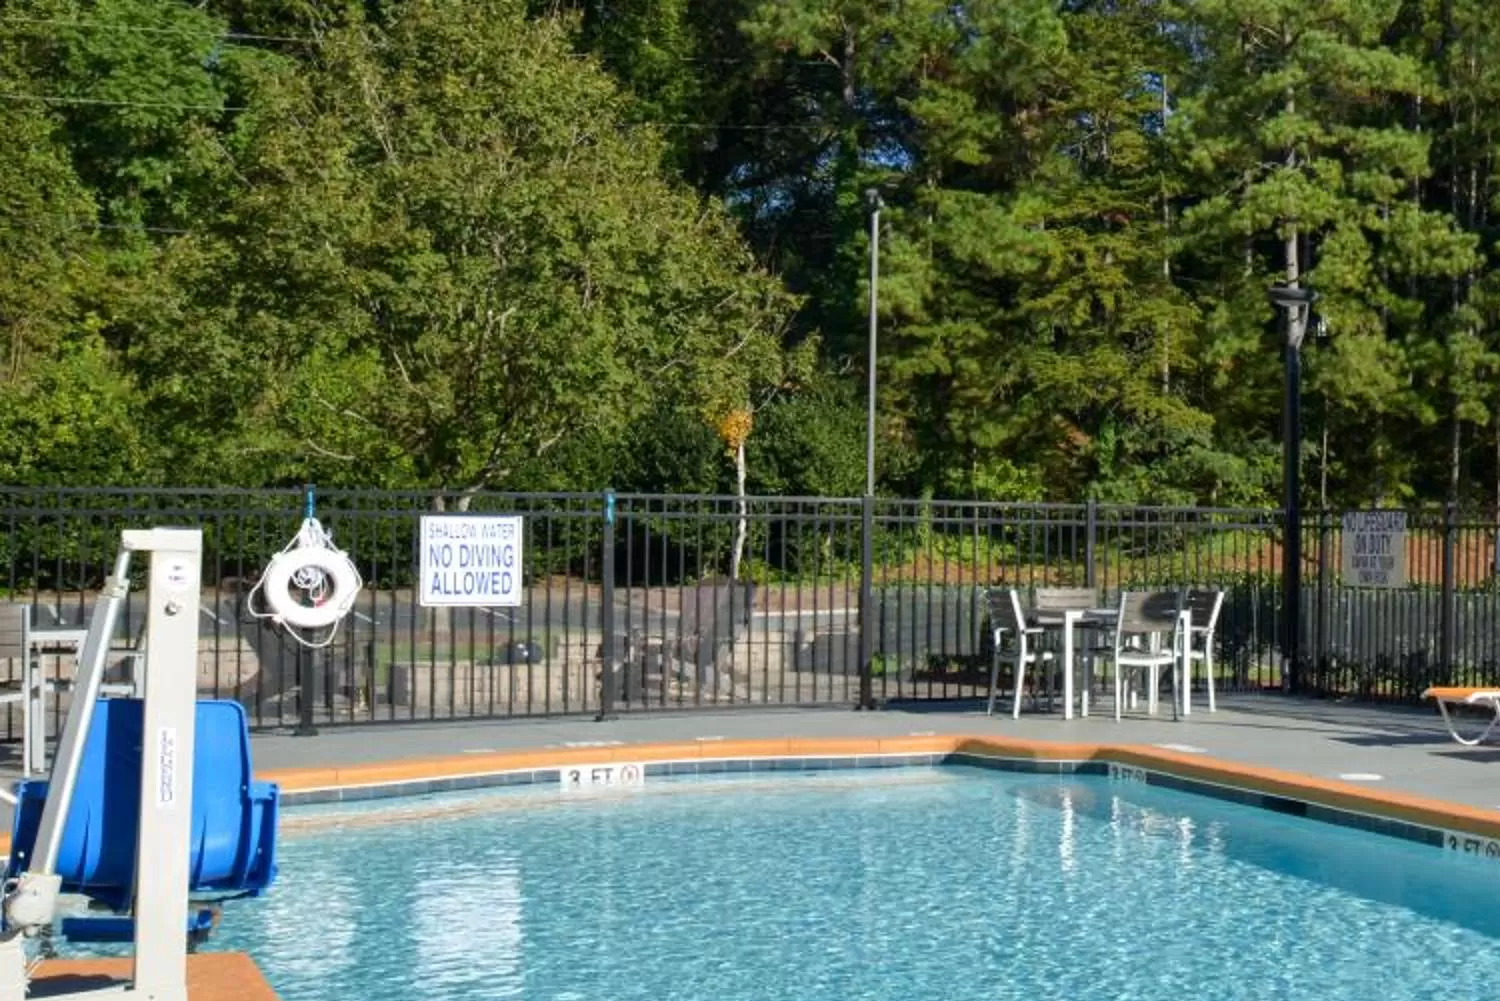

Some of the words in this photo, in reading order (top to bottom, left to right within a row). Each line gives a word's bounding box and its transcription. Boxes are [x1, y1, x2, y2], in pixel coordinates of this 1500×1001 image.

[429, 523, 477, 539] SHALLOW
[481, 523, 515, 539] WATER
[1355, 534, 1367, 554] ON
[1368, 534, 1392, 554] DUTY
[429, 544, 453, 568] NO
[459, 544, 514, 568] DIVING
[431, 572, 513, 595] ALLOWED
[591, 767, 614, 784] FT
[1464, 838, 1480, 856] FT
